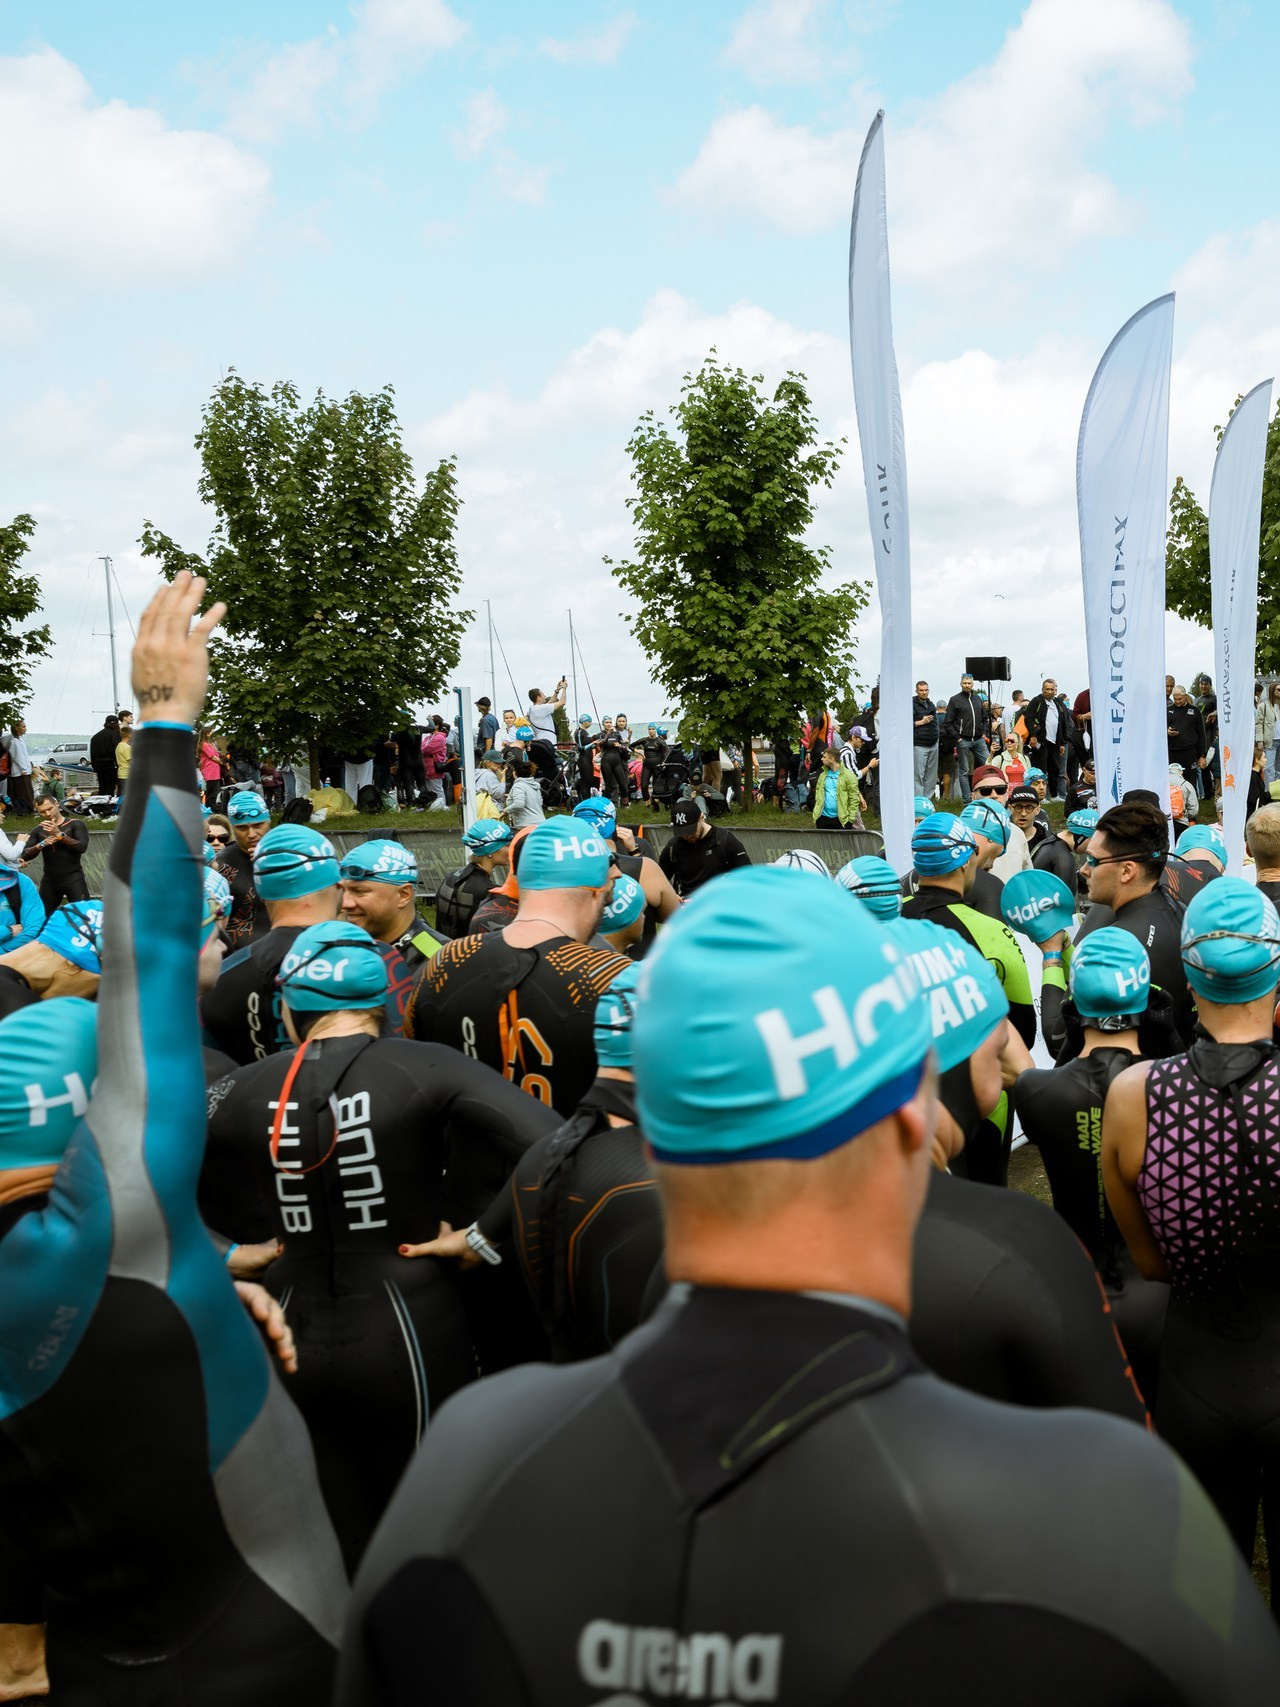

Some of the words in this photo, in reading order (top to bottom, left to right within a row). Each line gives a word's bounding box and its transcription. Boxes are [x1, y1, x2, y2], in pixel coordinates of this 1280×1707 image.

[1006, 891, 1061, 925] Haier
[336, 1091, 388, 1231] HUUB
[1076, 1111, 1091, 1151] MAD
[577, 1618, 783, 1701] arena
